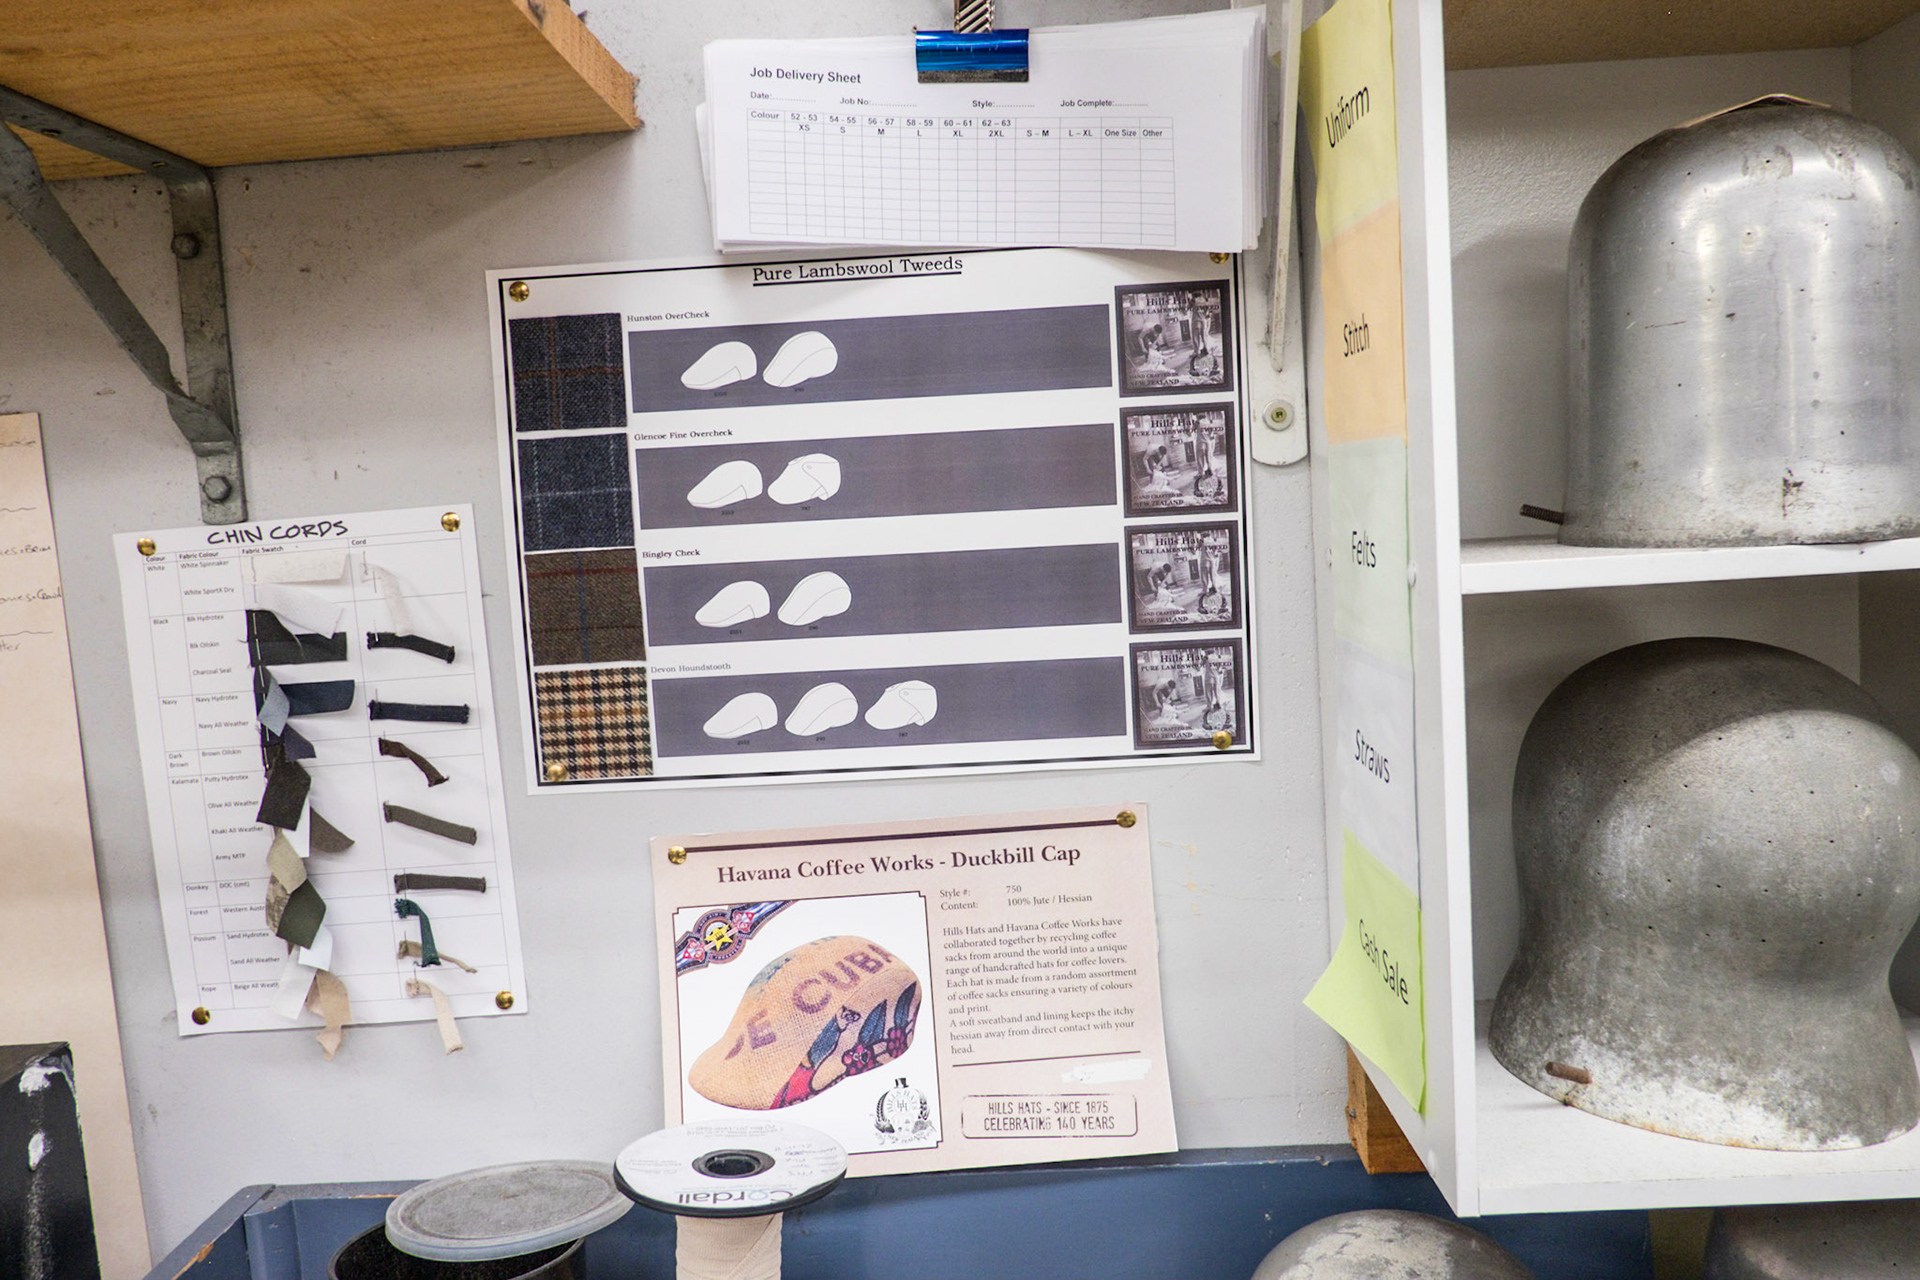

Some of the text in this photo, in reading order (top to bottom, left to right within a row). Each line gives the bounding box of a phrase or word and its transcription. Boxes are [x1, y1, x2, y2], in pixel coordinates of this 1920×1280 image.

[749, 66, 861, 84] Job Delivery Sheet
[750, 91, 773, 100] Date:
[839, 97, 871, 106] Job No:
[972, 99, 995, 110] Style:
[1060, 99, 1114, 109] Job Complete:
[750, 110, 780, 119] Colour
[790, 112, 800, 121] 52
[808, 113, 818, 122] 53
[829, 115, 839, 123] 54
[846, 116, 857, 124] 55
[1326, 86, 1370, 148] Uniform
[867, 117, 878, 125] 56
[885, 117, 895, 126] 57
[906, 118, 916, 127] 58
[923, 119, 934, 127] 59
[943, 119, 954, 128] 60
[962, 119, 973, 127] 61
[981, 119, 992, 127] 62
[1001, 119, 1012, 127] 63
[798, 123, 810, 132] XS
[840, 125, 846, 134] S
[877, 128, 885, 136] M
[917, 128, 922, 137] L
[988, 129, 1005, 137] 2XL
[1068, 129, 1074, 137] L
[1082, 129, 1093, 137] XL
[1104, 128, 1137, 137] One Size
[1142, 128, 1163, 137] Other
[952, 129, 964, 138] XL
[1026, 129, 1033, 138] S
[1041, 129, 1049, 137] M
[753, 256, 964, 282] Pure Lambswool Tweeds
[627, 310, 710, 322] Hunston OverCheck
[1343, 313, 1370, 357] Stitch
[1151, 417, 1200, 428] Hills Hats
[633, 428, 733, 441] Glencoe Fine Overcheck
[207, 520, 348, 544] CHIN CORDS
[1155, 536, 1204, 547] Hills Hats
[242, 545, 284, 555] Fabric Swatch
[642, 548, 701, 559] Bingley Check
[1351, 530, 1376, 568] Felts
[145, 555, 166, 563] Colour
[178, 550, 219, 560] Fabric Colour
[1160, 653, 1208, 663] Hills Hats
[650, 662, 731, 674] Devon Houndstooth
[1355, 729, 1390, 784] Straws
[716, 865, 793, 884] Havana
[797, 858, 866, 879] Coffee
[869, 854, 935, 874] Works
[950, 846, 1036, 870] Duckbill
[1041, 844, 1082, 867] Cap
[939, 888, 972, 901] Style #:
[1005, 884, 1023, 895] 750
[1007, 897, 1032, 907] 100%
[1033, 896, 1051, 907] Jute
[1058, 894, 1093, 904] Hessian
[940, 901, 979, 912] Content:
[942, 917, 1122, 937] Hills Hats and Havana Coffee Works have
[943, 929, 1117, 951] collaborated together by recycling coffee
[944, 943, 1128, 963] sacks from around the world into a unique
[1359, 919, 1409, 1005] Cash Sale
[948, 1003, 991, 1017] and print.
[950, 1043, 975, 1055] head.
[988, 1101, 1014, 1115] HILLS
[1017, 1101, 1042, 1115] HATS
[1053, 1100, 1081, 1114] SINCE
[1085, 1100, 1109, 1114] 1875
[983, 1115, 1115, 1132] CELEBRATING 140 YEARS
[678, 1190, 794, 1204] Cordall
